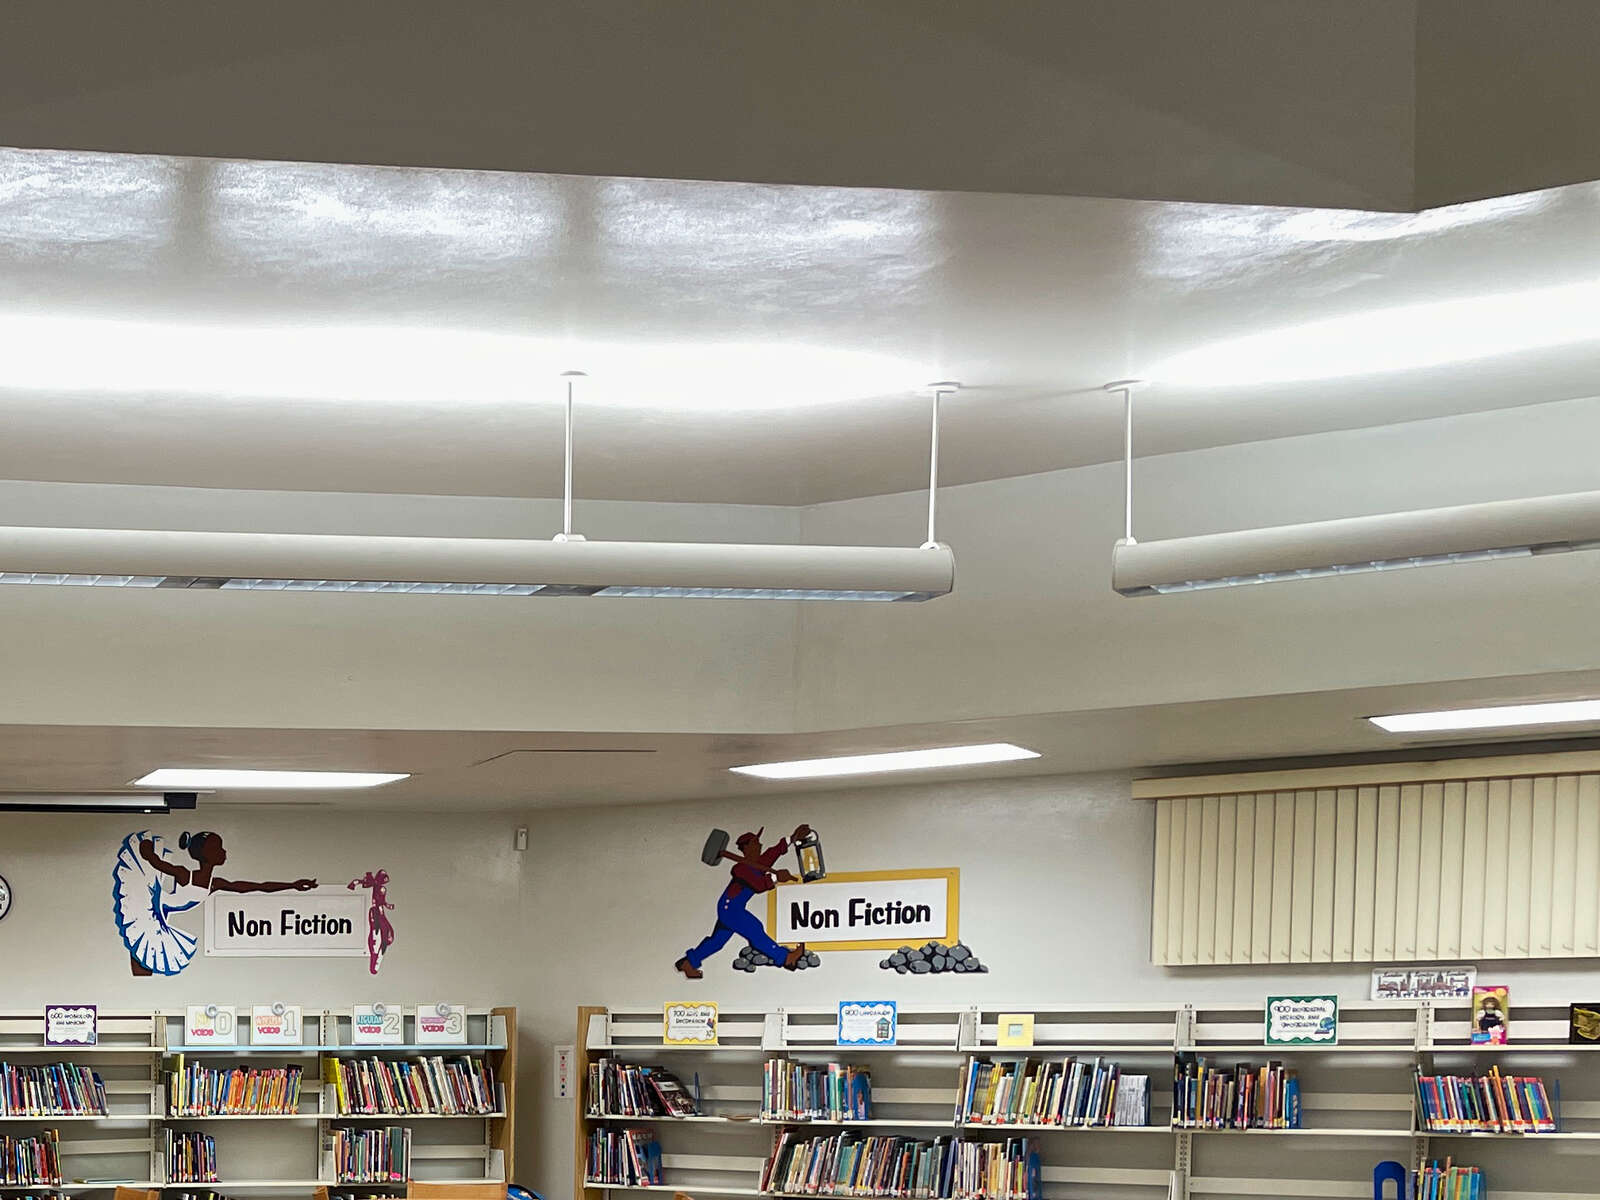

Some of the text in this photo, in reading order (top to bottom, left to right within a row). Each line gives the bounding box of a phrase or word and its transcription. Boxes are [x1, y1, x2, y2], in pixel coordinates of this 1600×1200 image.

[228, 910, 352, 937] Non Fiction
[790, 898, 931, 930] Non Fiction
[283, 1010, 297, 1036] 1
[383, 1012, 400, 1035] 2
[445, 1012, 463, 1034] 3
